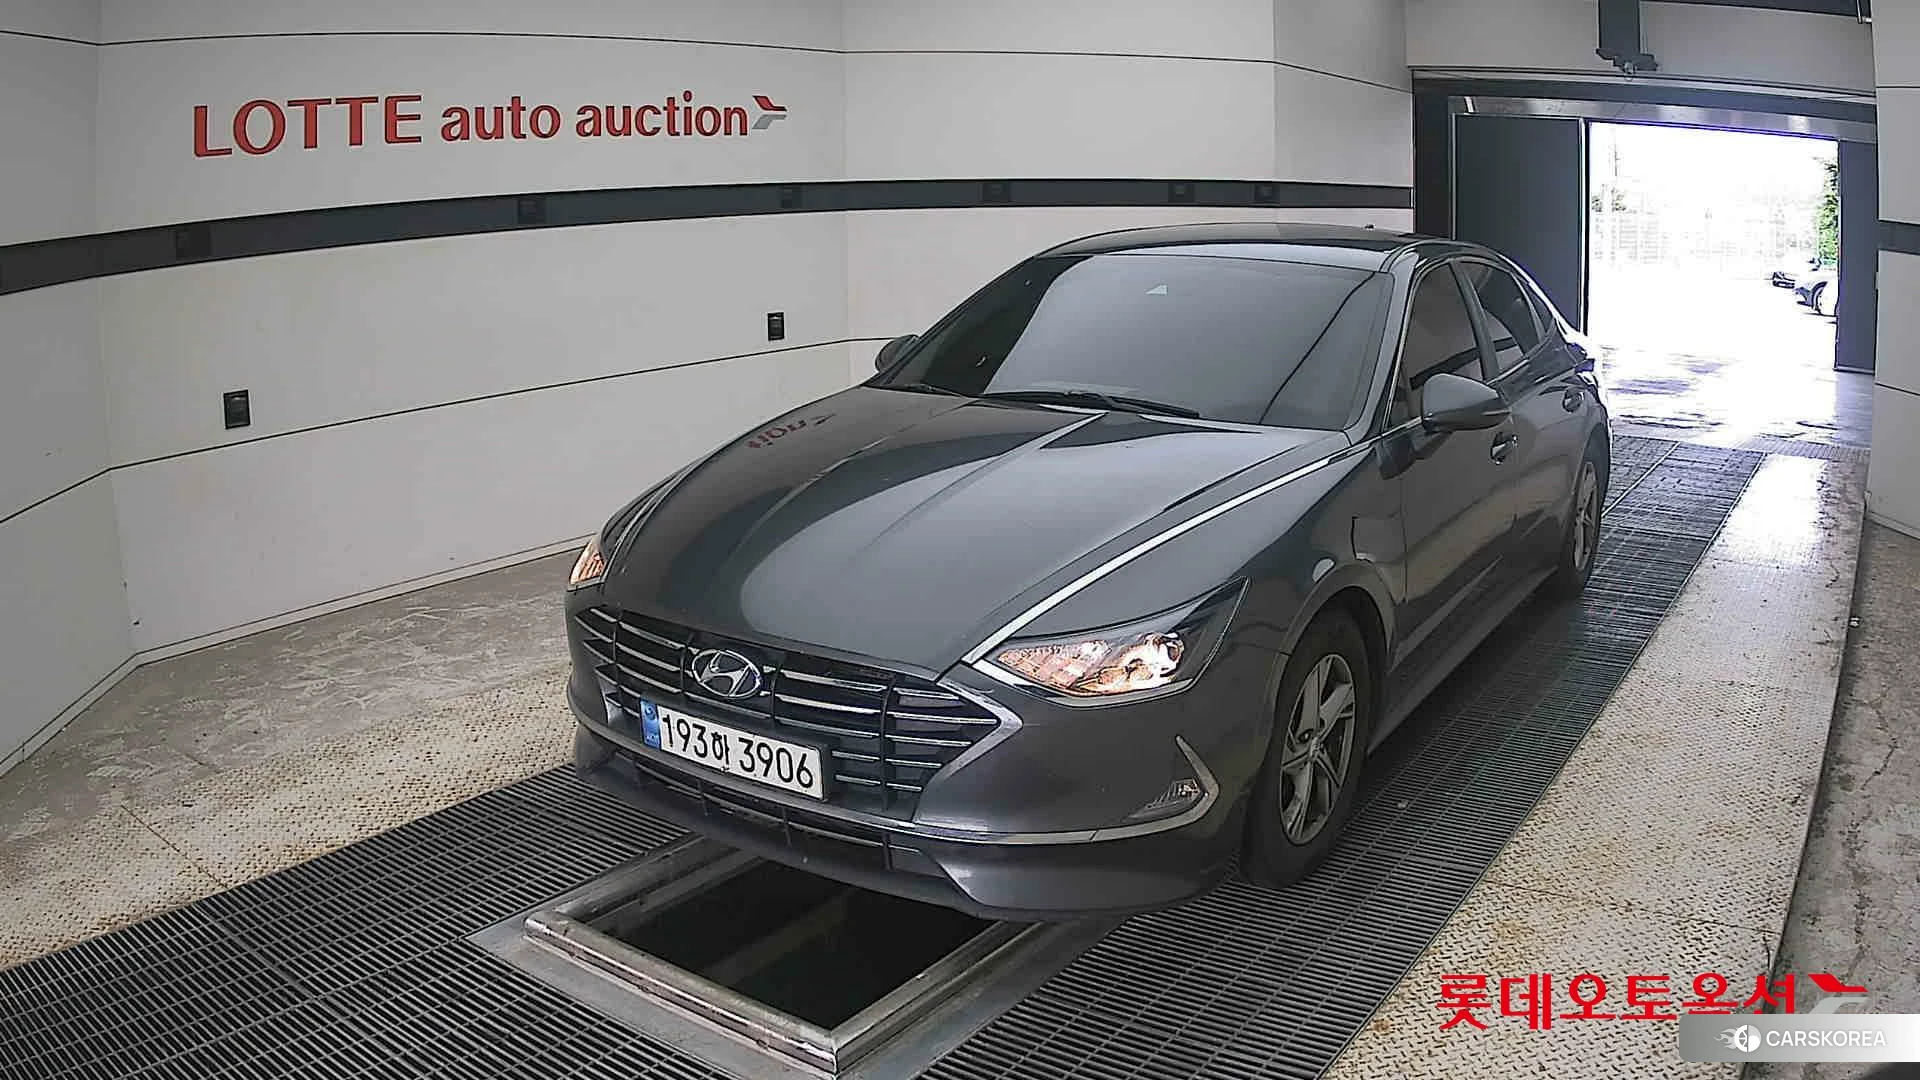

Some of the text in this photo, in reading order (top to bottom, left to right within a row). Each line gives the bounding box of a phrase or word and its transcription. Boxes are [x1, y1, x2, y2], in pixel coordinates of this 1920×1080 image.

[193, 90, 749, 158] LOTTE auto auction
[662, 713, 814, 789] 193하 3906
